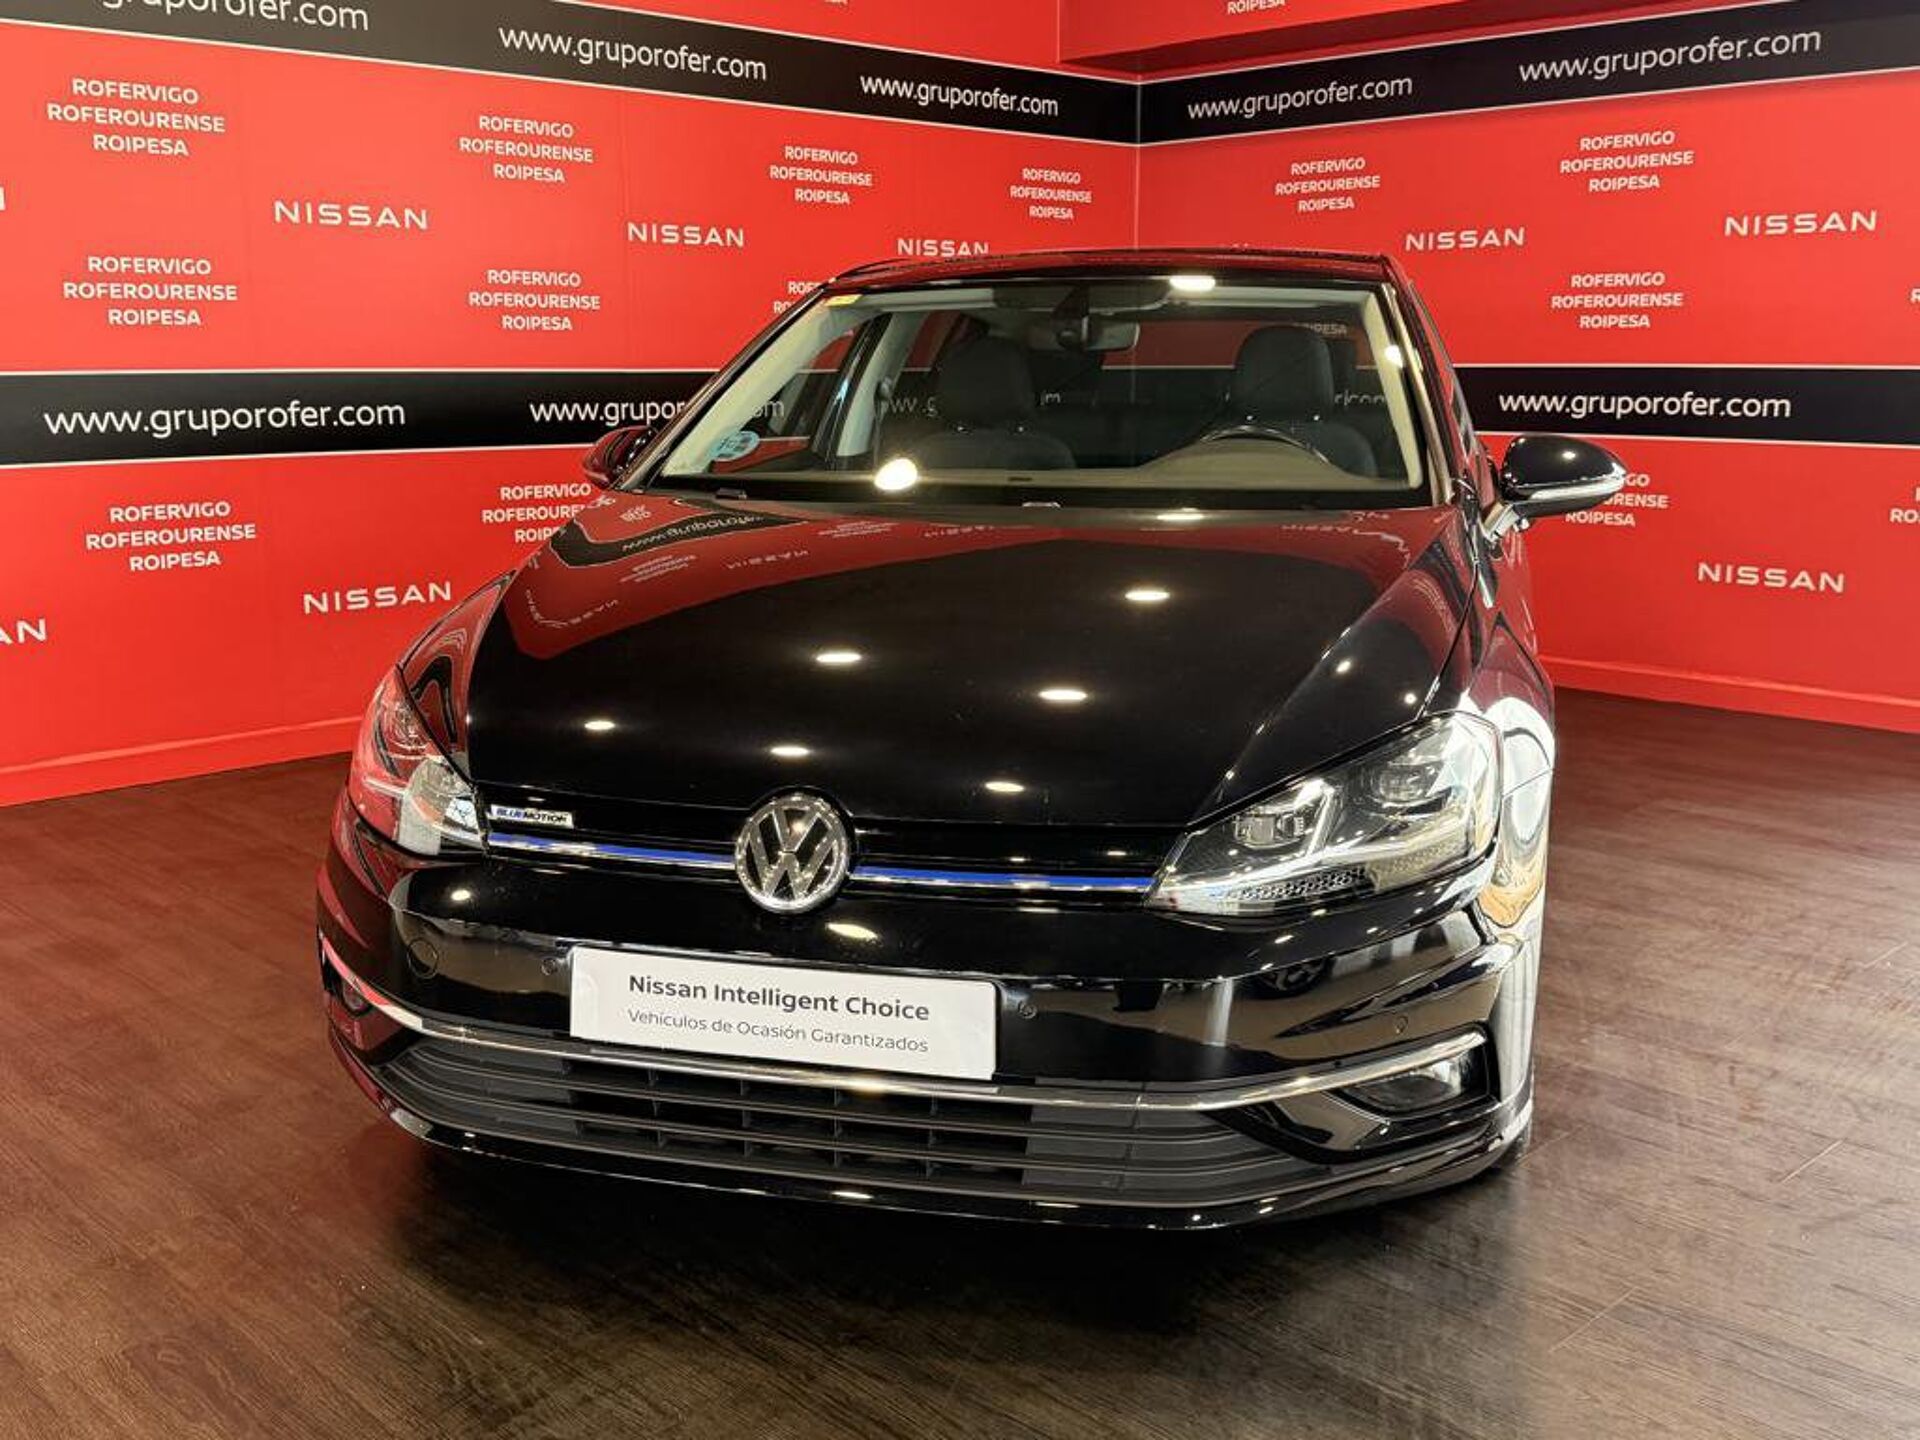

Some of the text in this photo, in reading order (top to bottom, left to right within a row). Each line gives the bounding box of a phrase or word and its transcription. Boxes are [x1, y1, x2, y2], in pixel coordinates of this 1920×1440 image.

[499, 27, 767, 80] www.gruporofer.com
[1519, 29, 1821, 82] www.gruporofer.com
[72, 79, 198, 104] ROFERVIGO
[860, 75, 1058, 116] www.gruporofer.com
[1188, 75, 1412, 120] www.gruporofer.com
[48, 103, 225, 132] ROFEROURENSE
[479, 116, 573, 137] ROFERVIGO
[94, 135, 188, 156] ROIPESA
[460, 138, 592, 162] ROFEROURENSE
[1581, 131, 1674, 152] ROFERVIGO
[785, 146, 857, 165] ROFERVIGO
[1291, 157, 1366, 174] ROFERVIGO
[1560, 151, 1694, 173] ROFEROURENSE
[494, 164, 564, 183] ROIPESA
[770, 166, 872, 186] ROFEROURENSE
[1023, 168, 1080, 184] ROFERVIGO
[1589, 175, 1660, 191] ROIPESA
[1010, 186, 1091, 203] ROFEROURENSE
[1276, 176, 1380, 195] ROFEROURENSE
[795, 189, 849, 204] ROIPESA
[1299, 197, 1354, 212] ROIPESA
[275, 201, 427, 229] NISSAN
[1029, 206, 1073, 220] ROIPESA
[1725, 211, 1876, 236] NISSAN
[628, 223, 743, 247] NISSAN
[1406, 228, 1525, 251] NISSAN
[898, 239, 988, 257] NISSAN
[88, 256, 211, 275] ROFERVIGO
[488, 269, 580, 288] ROFERVIGO
[1572, 271, 1665, 288] ROFERVIGO
[64, 282, 237, 301] ROFEROURENSE
[469, 291, 600, 310] ROFEROURENSE
[1552, 293, 1683, 309] ROFEROURENSE
[109, 308, 200, 326] ROIPESA
[502, 314, 572, 331] ROIPESA
[1580, 314, 1650, 329] ROIPESA
[1500, 391, 1791, 420] www.gruporofer.com
[44, 401, 404, 437] www.gruporofer.com
[501, 483, 592, 501] ROFERVIGO
[110, 500, 230, 523] ROFERVIGO
[86, 523, 255, 550] ROFEROURENSE
[130, 551, 220, 572] ROIPESA
[1699, 563, 1844, 592] NISSAN
[304, 582, 452, 613] NISSAN
[629, 975, 929, 1021] Nissan Intelligent Choice
[711, 1018, 733, 1033] de
[736, 1021, 806, 1040] Ocasión
[811, 1028, 929, 1052] Garantizados
